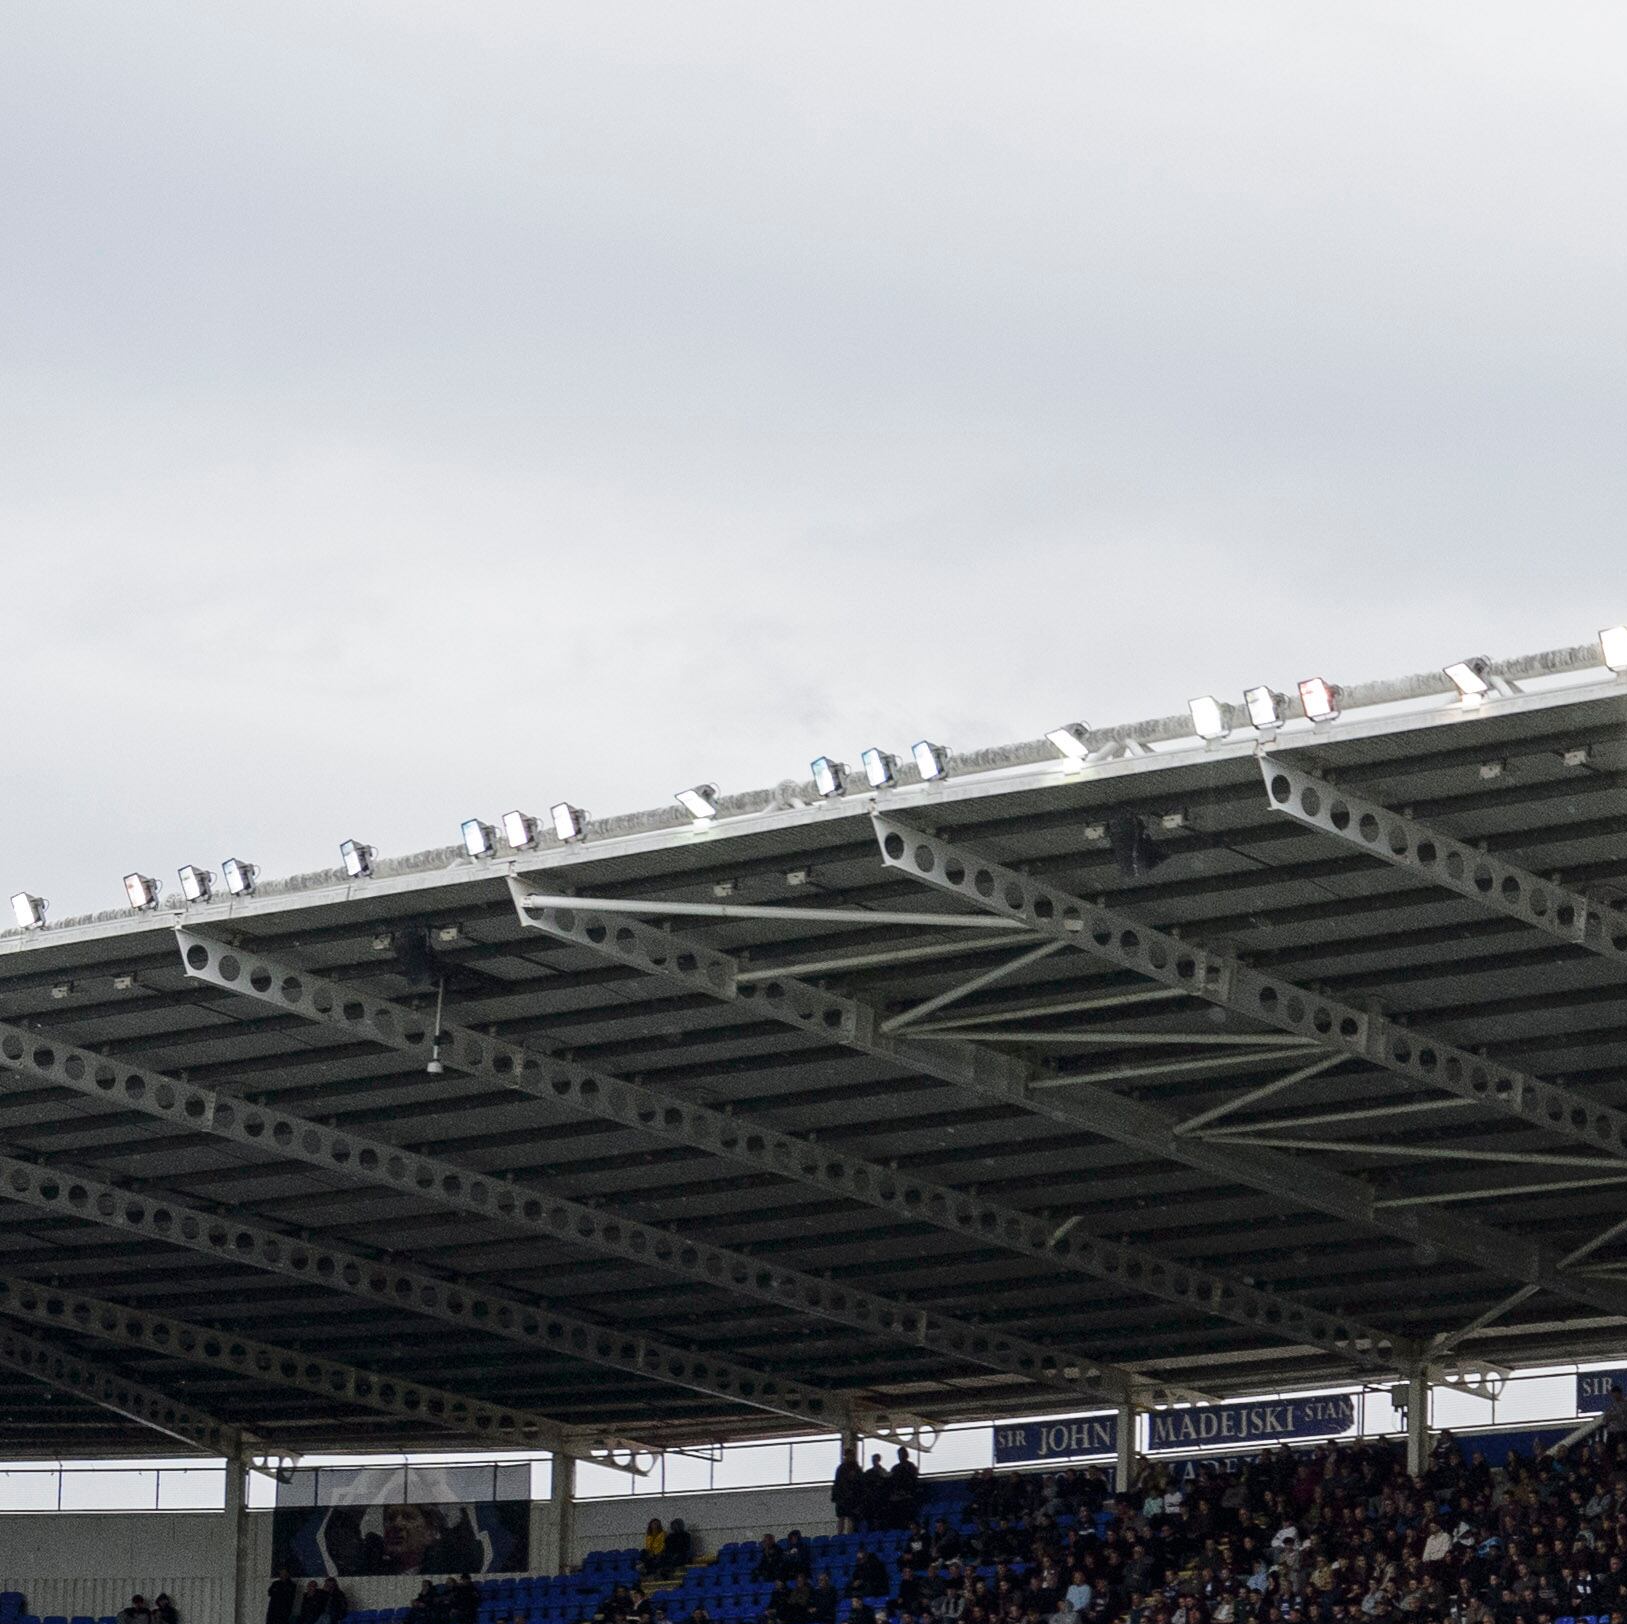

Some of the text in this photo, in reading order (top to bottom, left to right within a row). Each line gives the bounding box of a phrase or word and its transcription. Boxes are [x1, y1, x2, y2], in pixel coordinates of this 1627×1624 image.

[1582, 1376, 1613, 1397] SIR
[1038, 1420, 1111, 1455] JOHN
[1154, 1406, 1295, 1444] MADEJSKI
